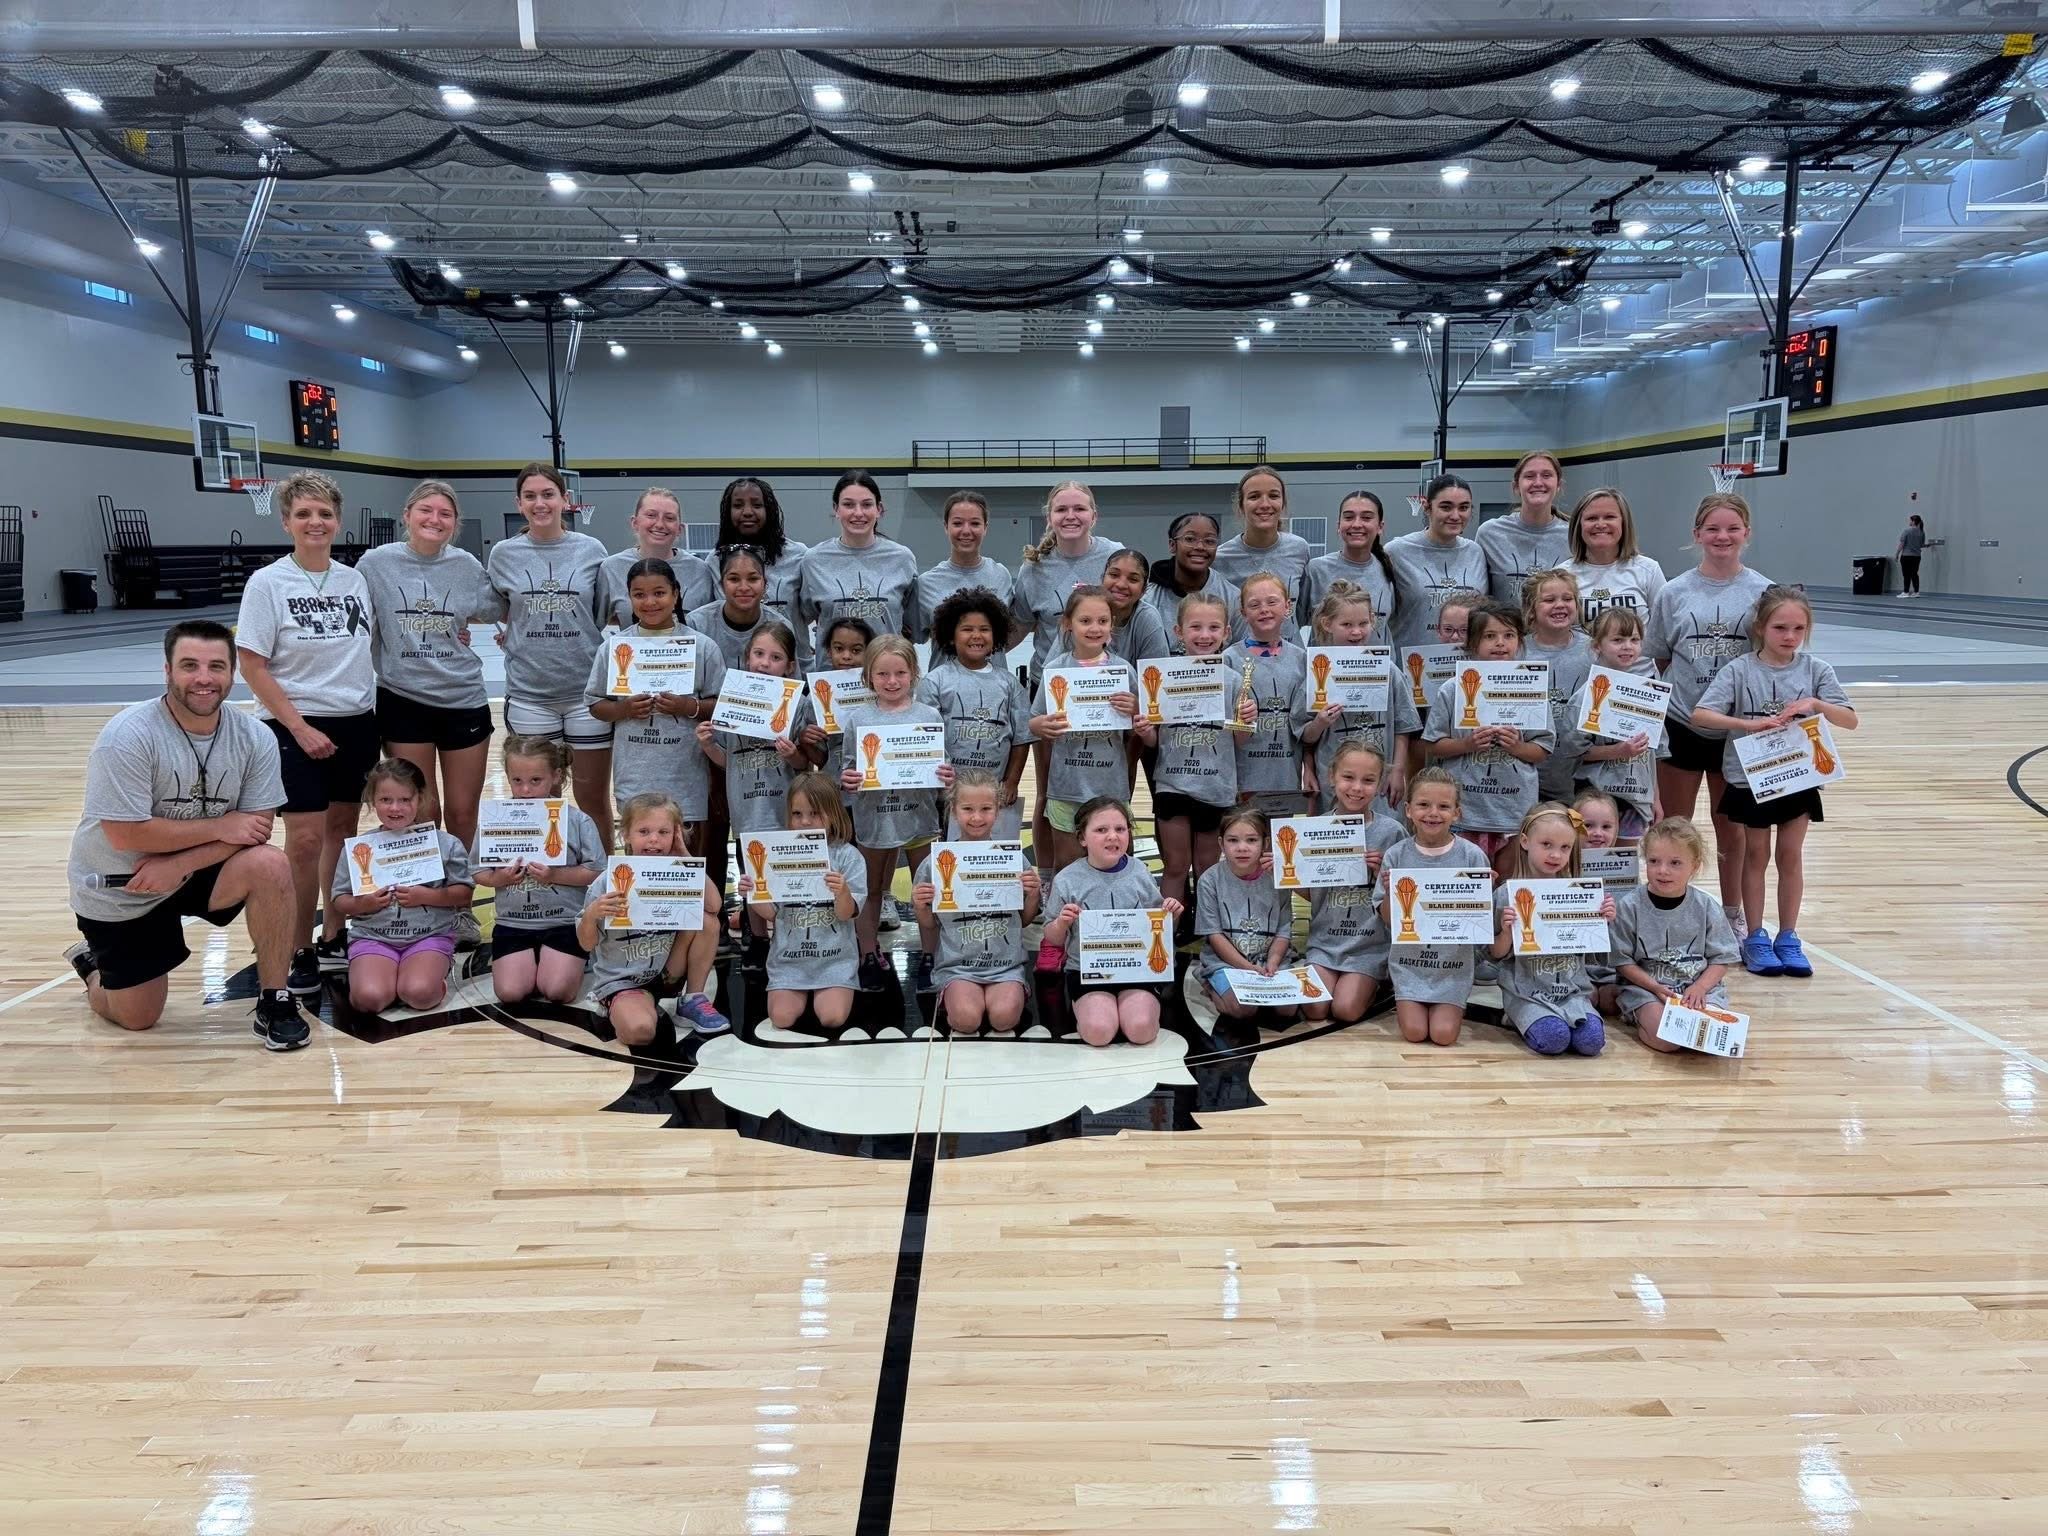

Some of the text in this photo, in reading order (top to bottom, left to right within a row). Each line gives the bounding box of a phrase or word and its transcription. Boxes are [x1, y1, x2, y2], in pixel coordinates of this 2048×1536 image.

[525, 597, 577, 614] TIGERS
[837, 603, 886, 618] TIGERS
[398, 618, 455, 634] TIGERS
[1688, 641, 1744, 659] TIGERS
[1167, 668, 1215, 676] CERTIFICATE
[1615, 685, 1661, 700] CERTIFICATE
[721, 712, 765, 725] CERTIFICATE
[955, 724, 1001, 741] TIGERS
[628, 736, 661, 744] BASKETBALL
[1171, 730, 1217, 747] TIGERS
[1077, 751, 1093, 759] 2026
[951, 758, 1000, 768] BASKETBALL CAMP
[1064, 758, 1095, 767] BASKETBALL
[1184, 759, 1200, 767] 2026
[1166, 767, 1202, 775] BASKETBALL
[1481, 778, 1497, 786] 2026
[1760, 769, 1809, 788] CERTIFICATE
[1462, 784, 1499, 794] BASKETBALL
[1303, 829, 1356, 837] CERTIFICATE
[378, 835, 428, 849] CERTIFICATE
[771, 844, 819, 852] CERTIFICATE
[508, 908, 564, 919] BASKETBALL CAMP
[412, 927, 432, 935] CAMP
[957, 920, 1008, 944] TIGERS
[783, 948, 841, 958] BASKETBALL CAMP
[1420, 951, 1438, 959] 2026
[1399, 958, 1440, 968] BASKETBALL
